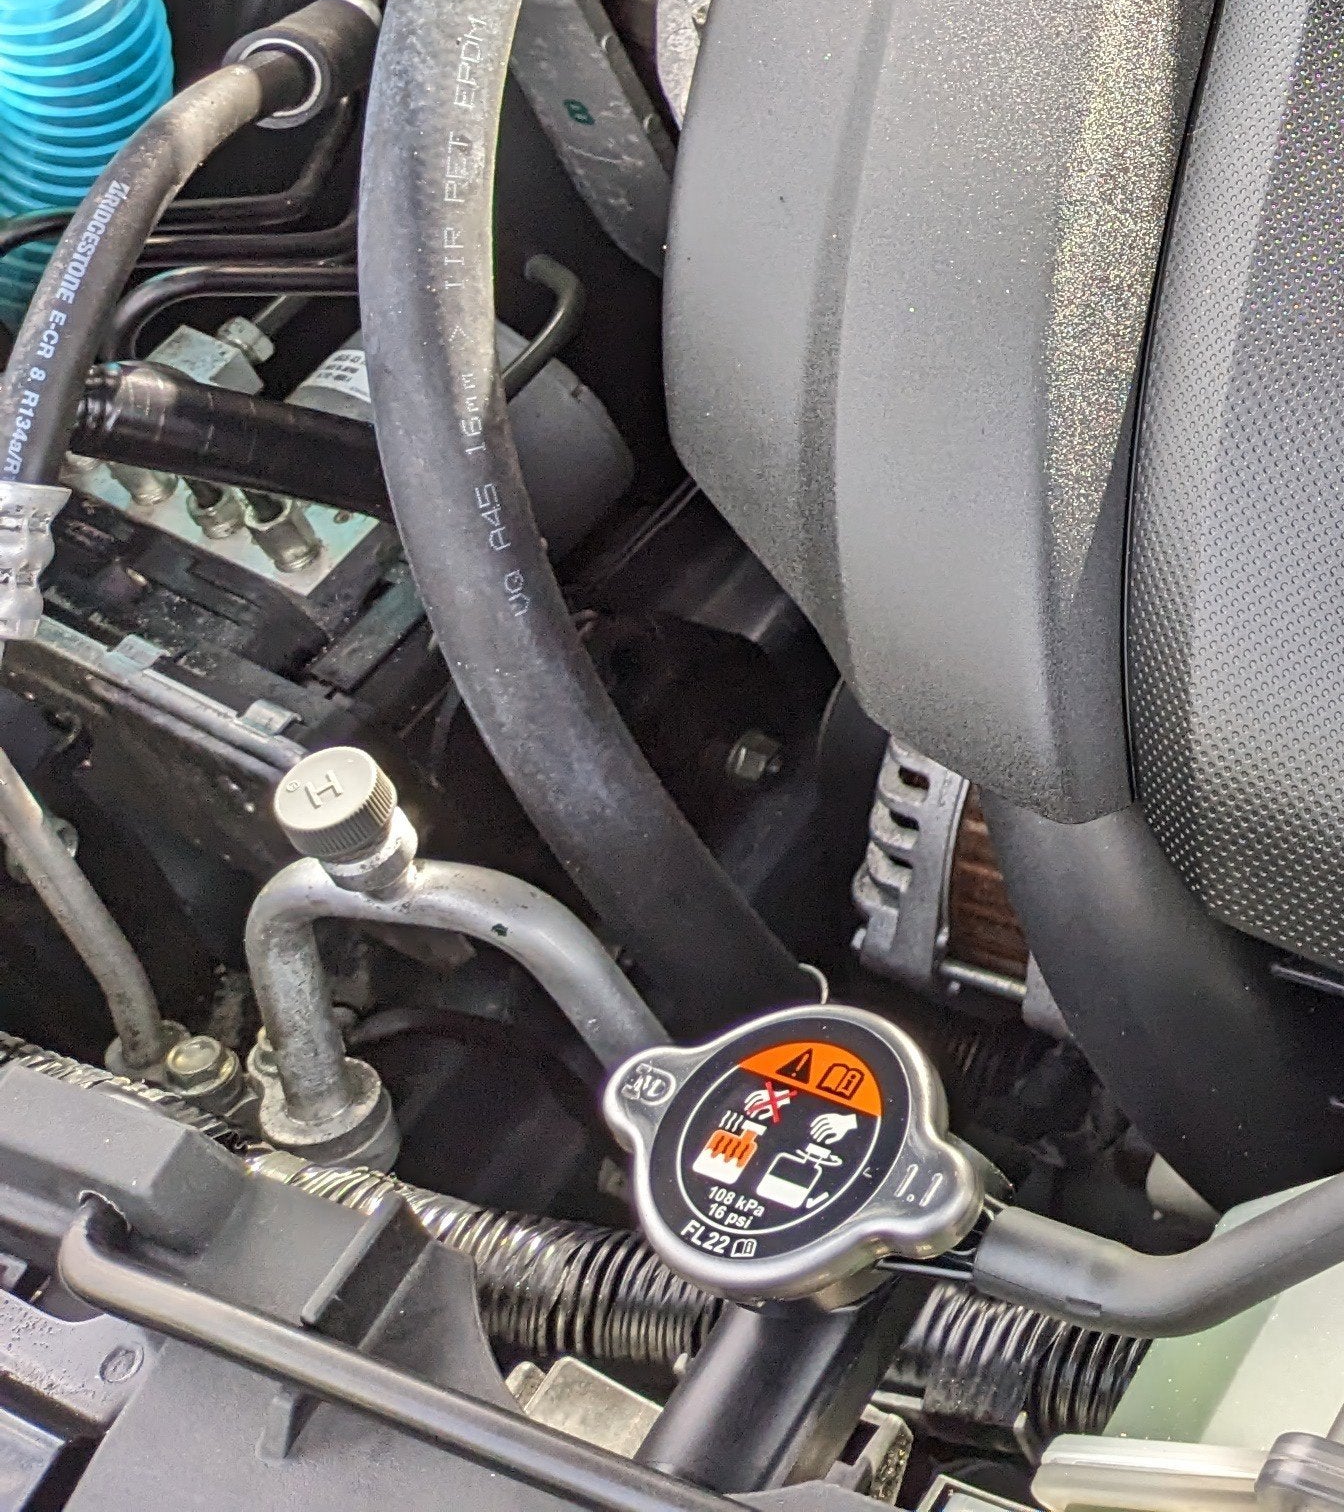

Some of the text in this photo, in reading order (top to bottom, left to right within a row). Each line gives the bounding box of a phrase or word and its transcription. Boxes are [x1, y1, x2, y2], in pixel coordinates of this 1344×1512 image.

[453, 14, 488, 109] EPDM
[55, 180, 131, 305] BRIDGESTONE
[36, 308, 68, 360] E-CR
[3, 389, 41, 483] R134a/R
[304, 769, 344, 810] H
[707, 1185, 766, 1218] 108 kPa
[894, 1163, 944, 1207] 1.1
[680, 1218, 732, 1255] FL22
[707, 1203, 753, 1230] 16 psi
